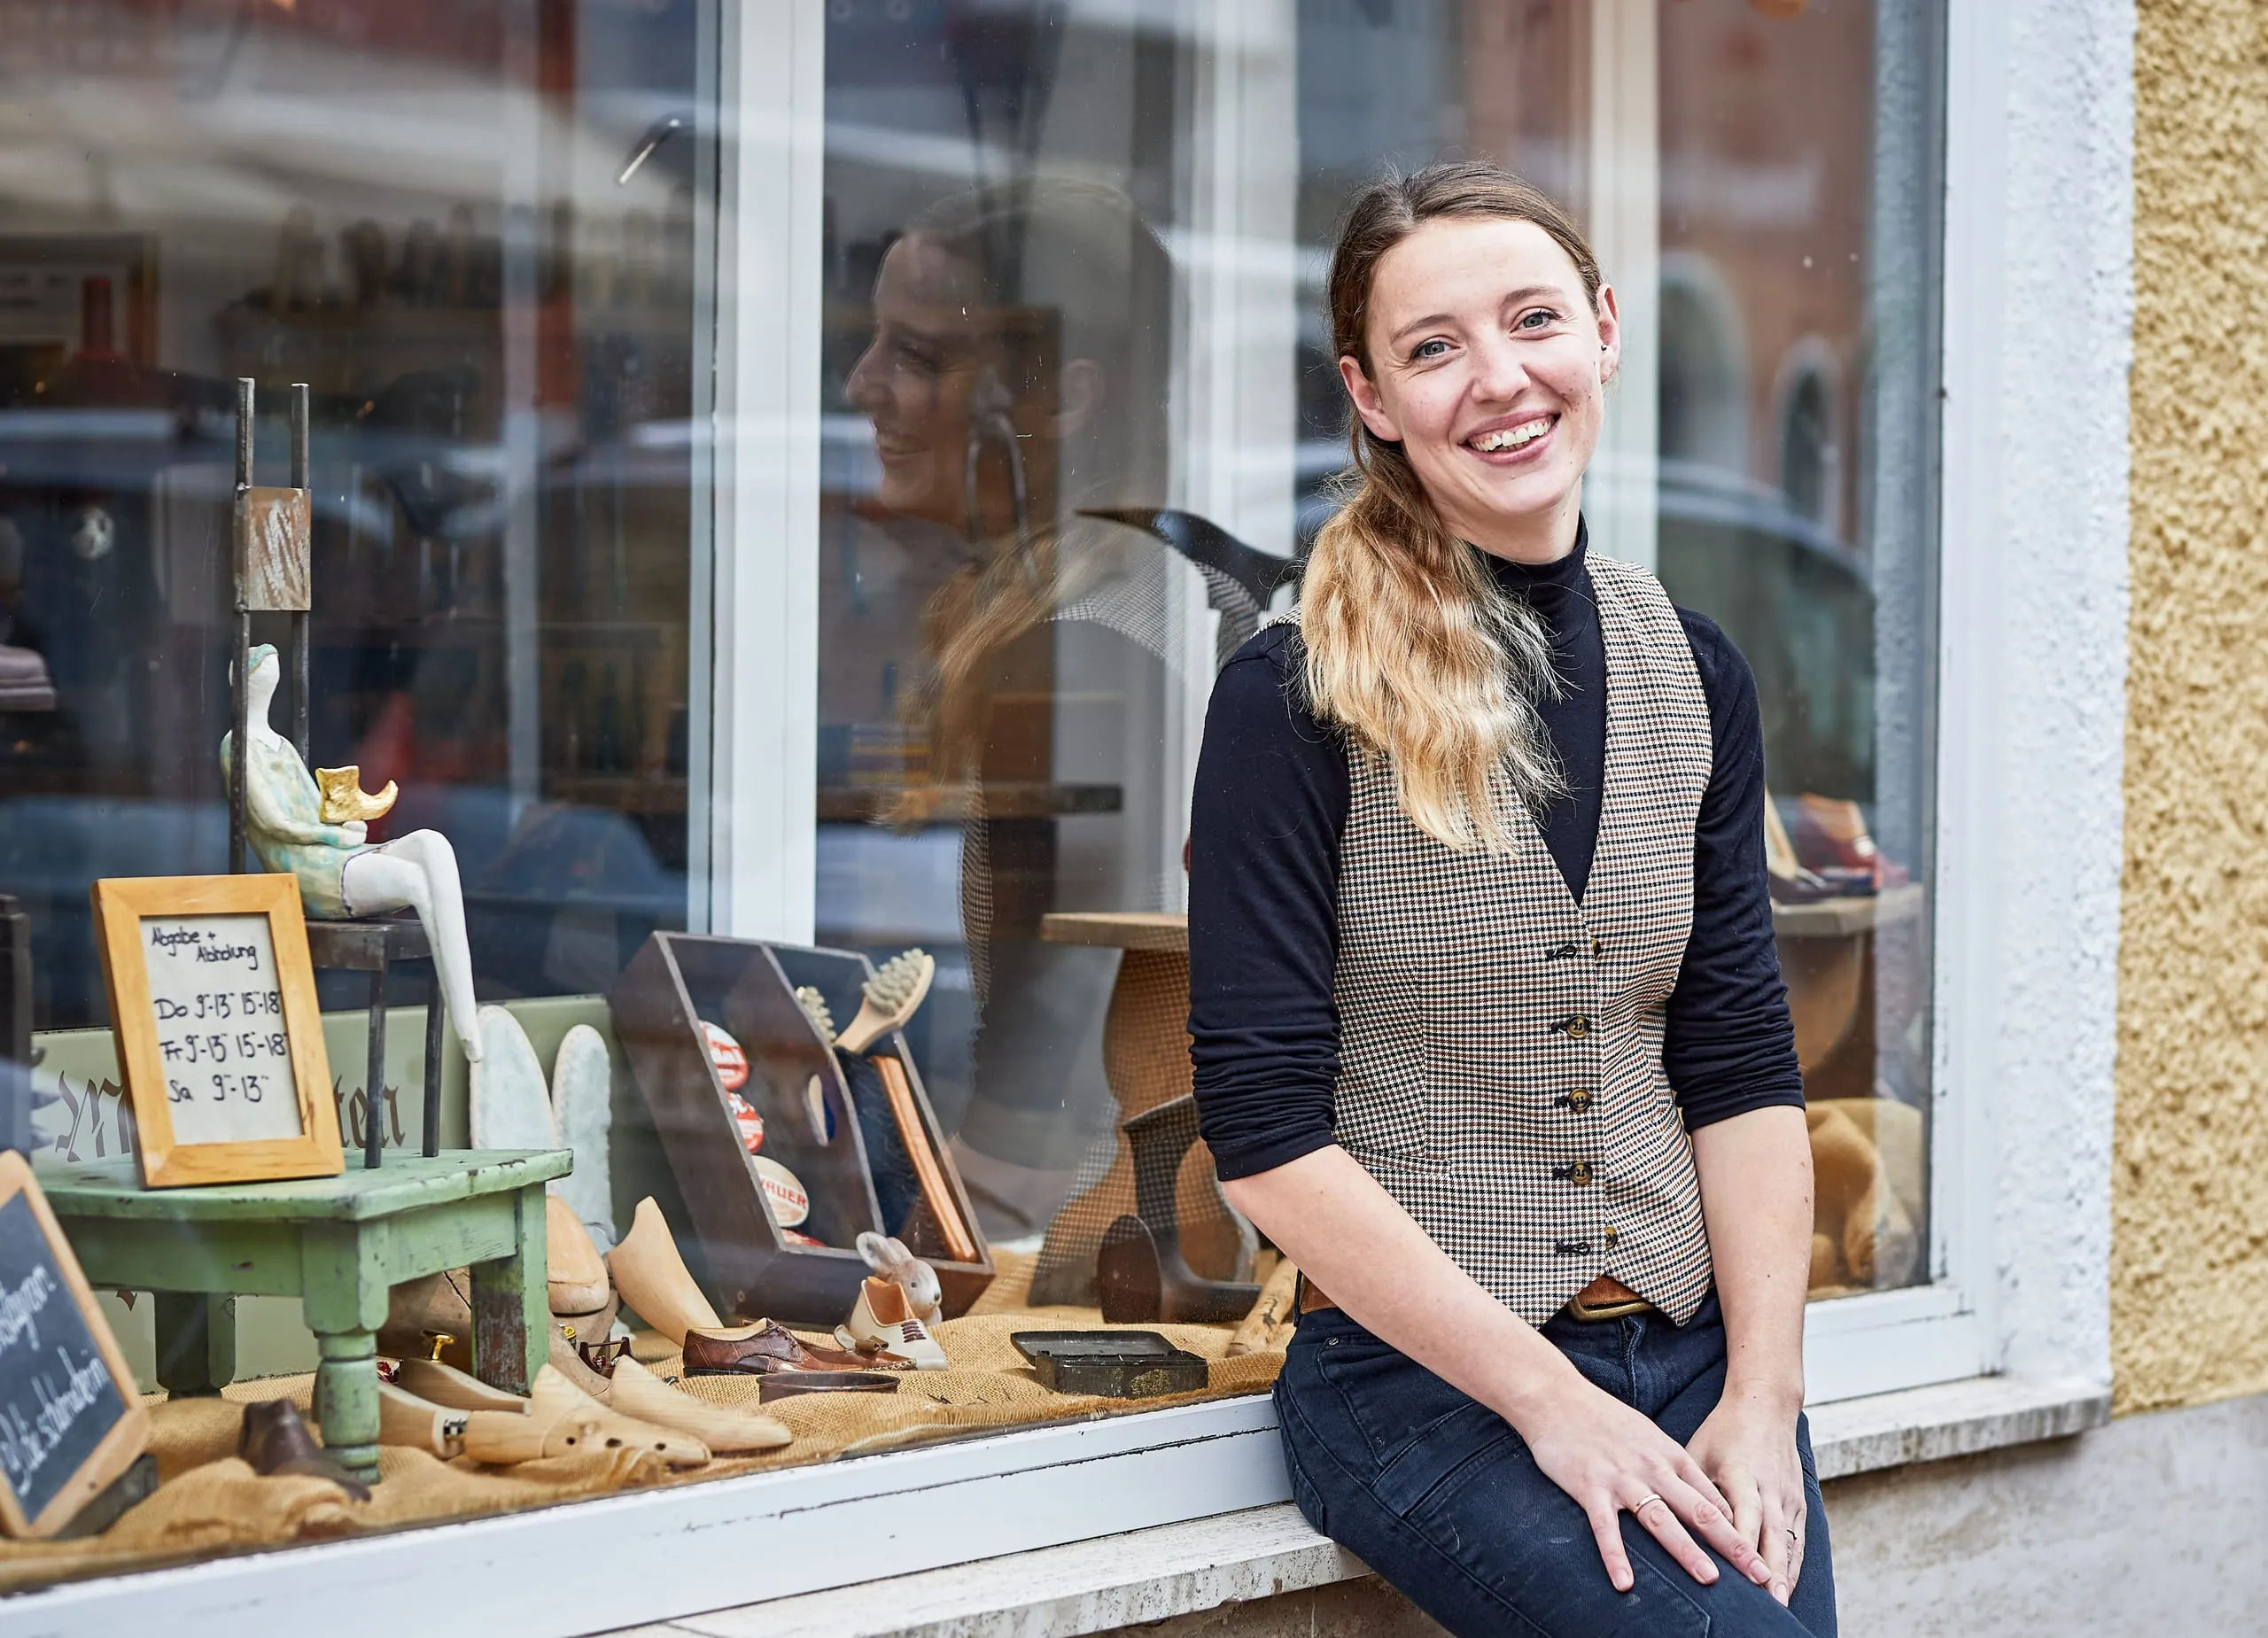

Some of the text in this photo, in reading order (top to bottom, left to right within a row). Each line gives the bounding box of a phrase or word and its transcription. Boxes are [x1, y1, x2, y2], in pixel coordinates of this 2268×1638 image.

[151, 925, 200, 957] Abgabe
[196, 943, 259, 971] Abholung
[153, 998, 189, 1020] Do
[159, 1040, 183, 1061] Fr
[167, 1079, 194, 1103] Sa
